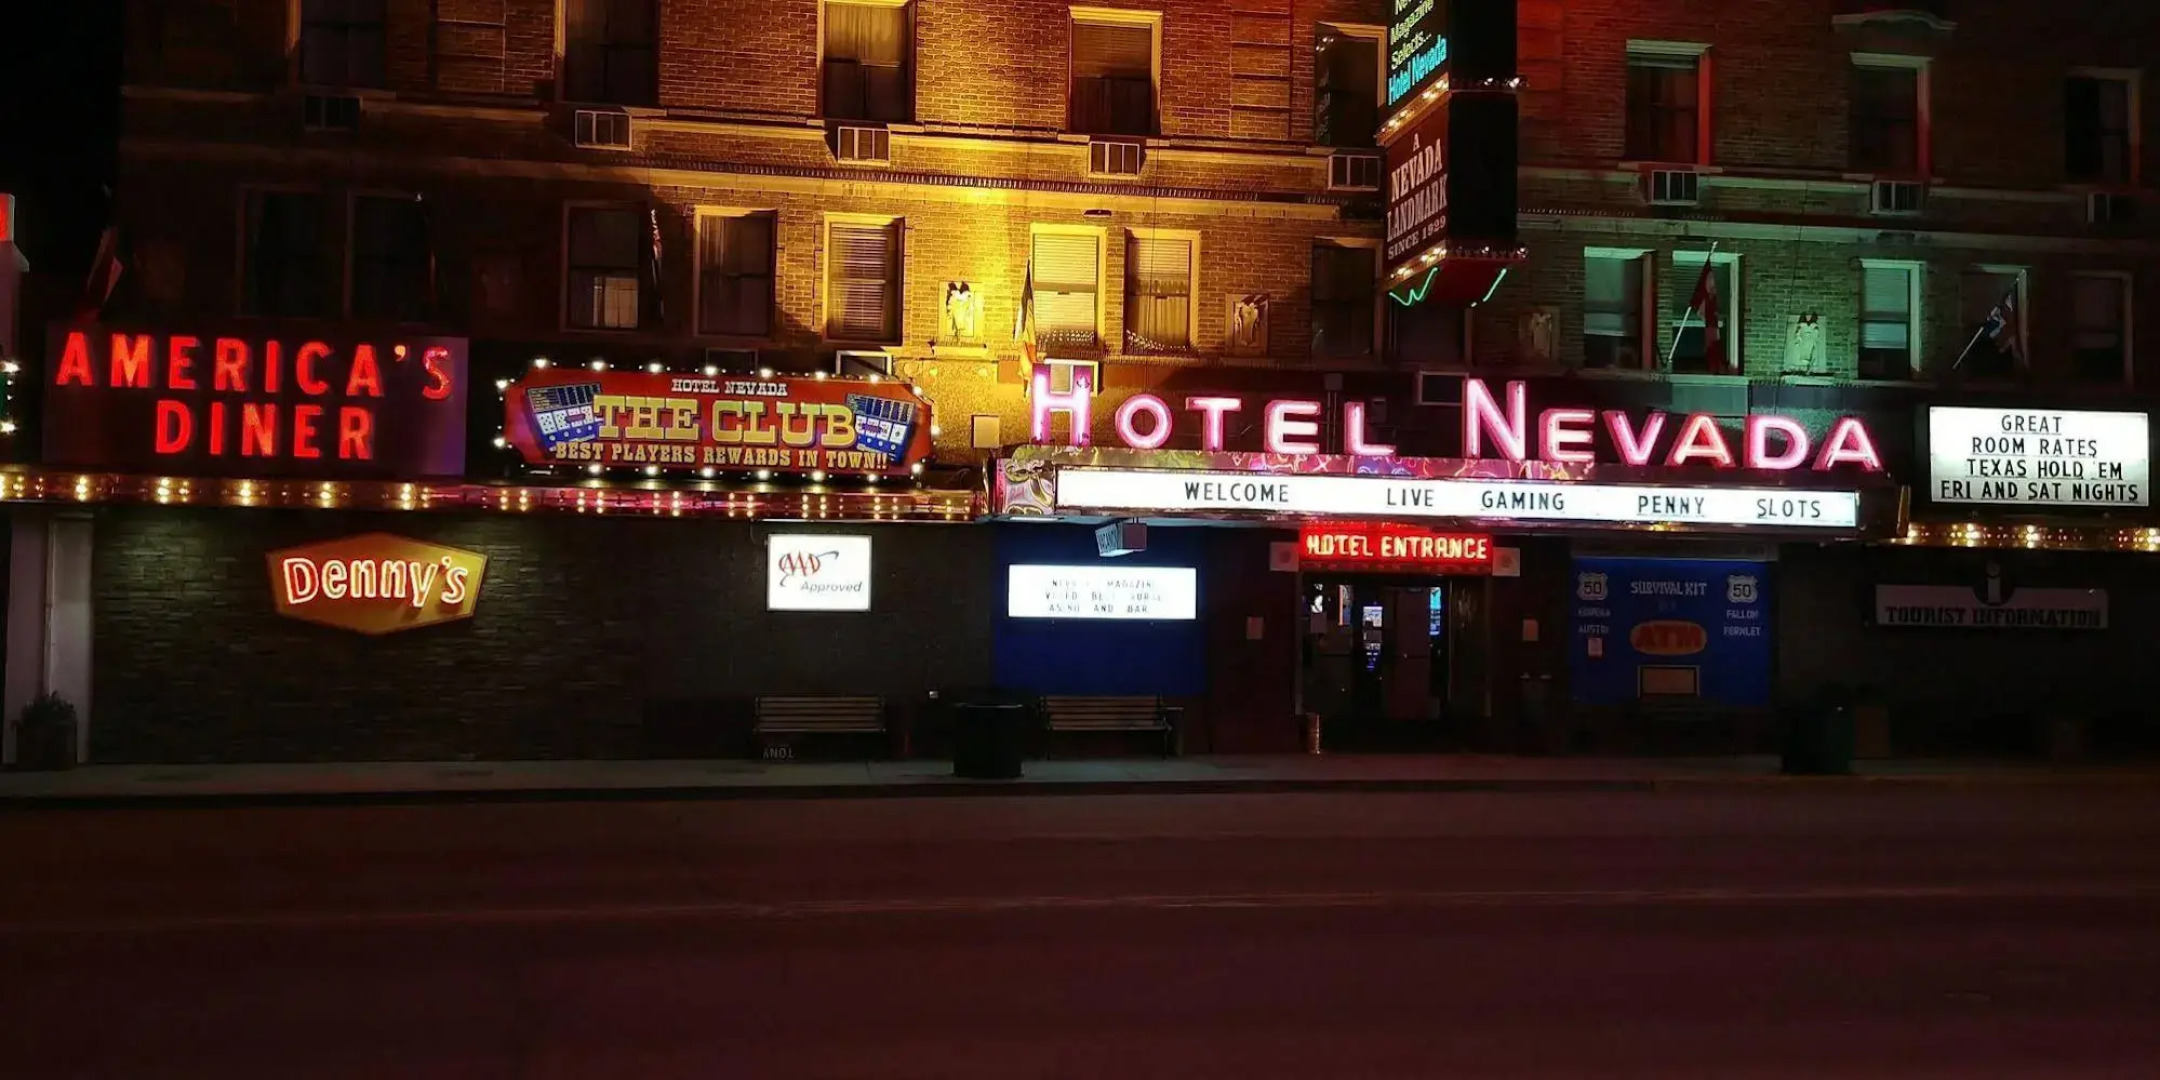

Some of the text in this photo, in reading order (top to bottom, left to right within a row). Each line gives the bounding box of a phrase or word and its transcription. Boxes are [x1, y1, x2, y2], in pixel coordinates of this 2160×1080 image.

[1388, 34, 1448, 106] Hotel Nevada
[1412, 133, 1420, 151] A
[1391, 138, 1443, 203] NEVADA
[1387, 173, 1448, 242] LANDMARK
[1388, 215, 1447, 260] SINCE 1929
[56, 331, 453, 399] AMERICA'S
[671, 378, 788, 397] HOTEL NEVADA
[155, 400, 374, 460] DINER
[593, 394, 699, 441] THE
[711, 399, 858, 448] CLUB
[1031, 363, 1884, 473] HOTEL NEVADA
[2001, 415, 2062, 433] GREAT
[555, 442, 888, 470] BEST PLAYERS REWARDS IN TOWN!!
[1972, 437, 2097, 457] ROOM RATES
[1967, 458, 2027, 477] TEXAS
[2037, 461, 2084, 479] HOLD
[1185, 482, 1821, 518] WELCOME LIVE GAMING PENNY SLOTS
[1941, 480, 2138, 501] FRI AND SAT NIGHTS
[1306, 535, 1488, 559] HOTEL ENTRANCE
[283, 556, 468, 608] Denny's
[800, 581, 863, 594] Approved
[1584, 581, 1602, 596] 50
[1733, 583, 1751, 598] 50
[1885, 605, 2101, 627] TOURIST INFORMATION
